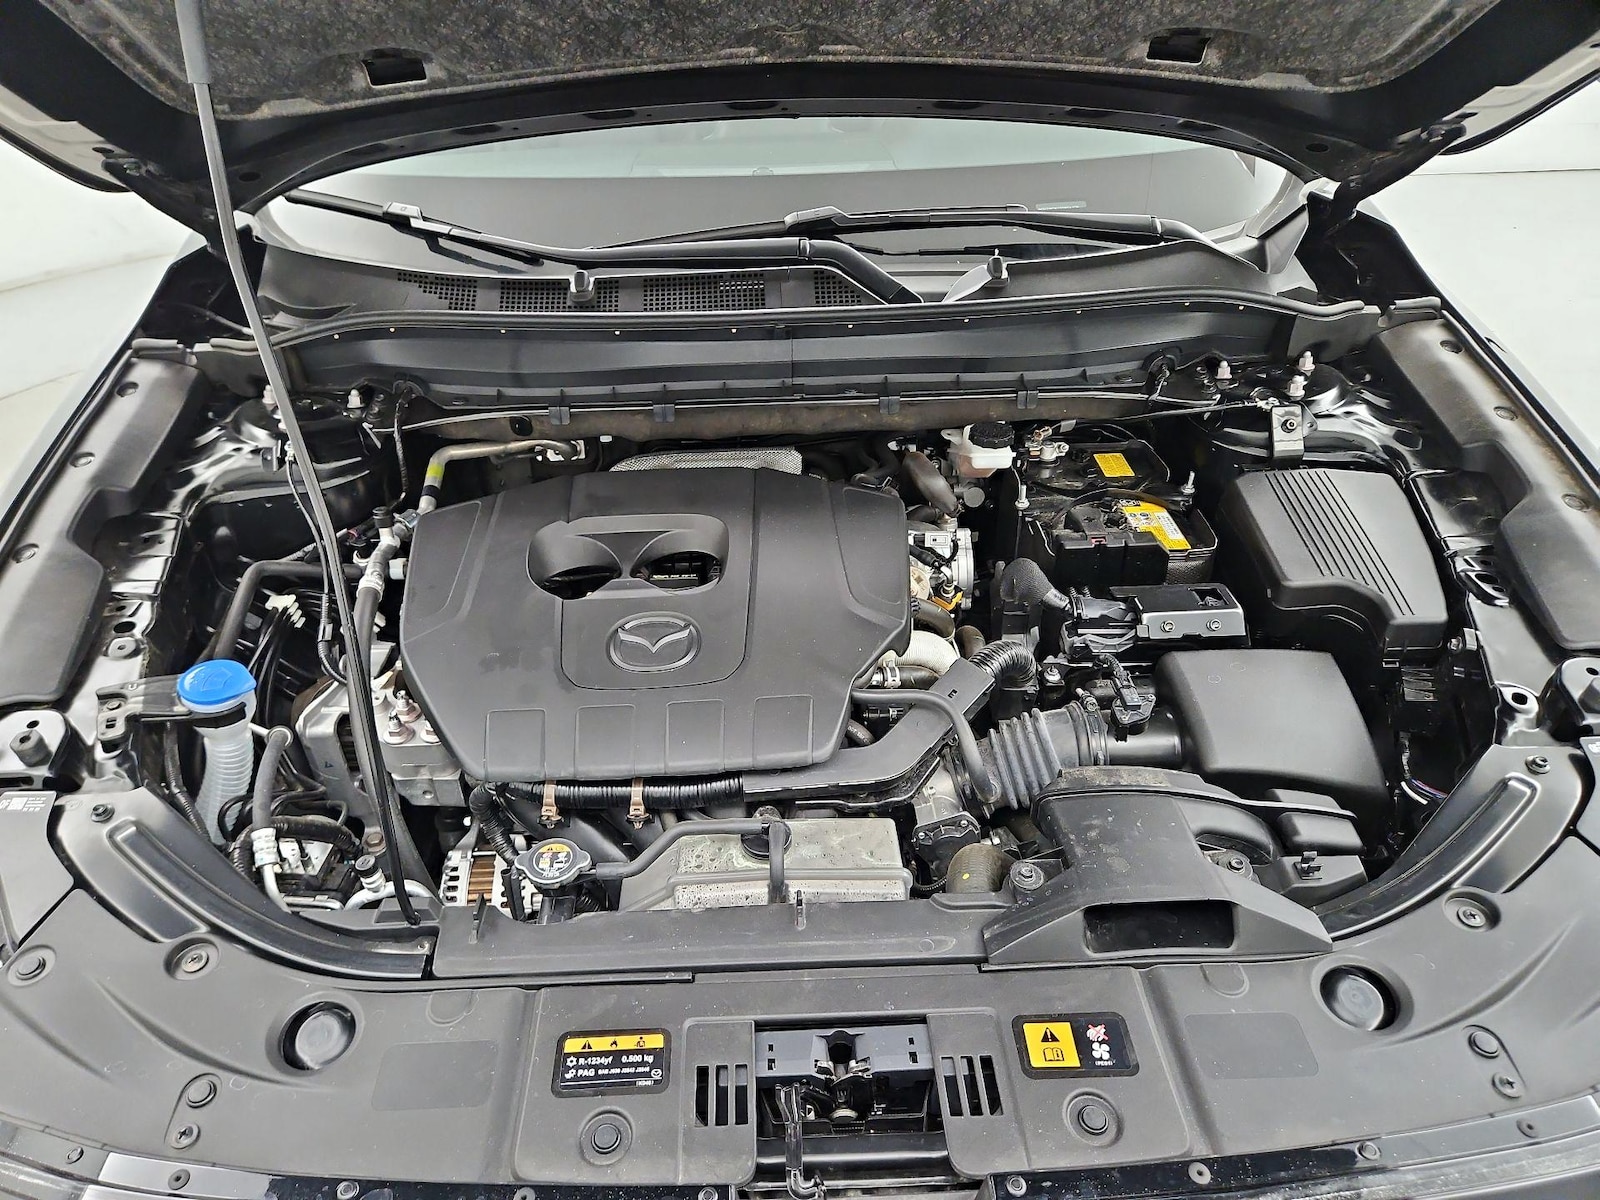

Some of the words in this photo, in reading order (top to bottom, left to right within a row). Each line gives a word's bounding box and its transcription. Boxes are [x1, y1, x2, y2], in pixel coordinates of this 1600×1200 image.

[578, 1056, 613, 1066] R-1234yf
[621, 1054, 641, 1063] 0.500
[643, 1054, 654, 1064] kg
[577, 1068, 595, 1078] PAG
